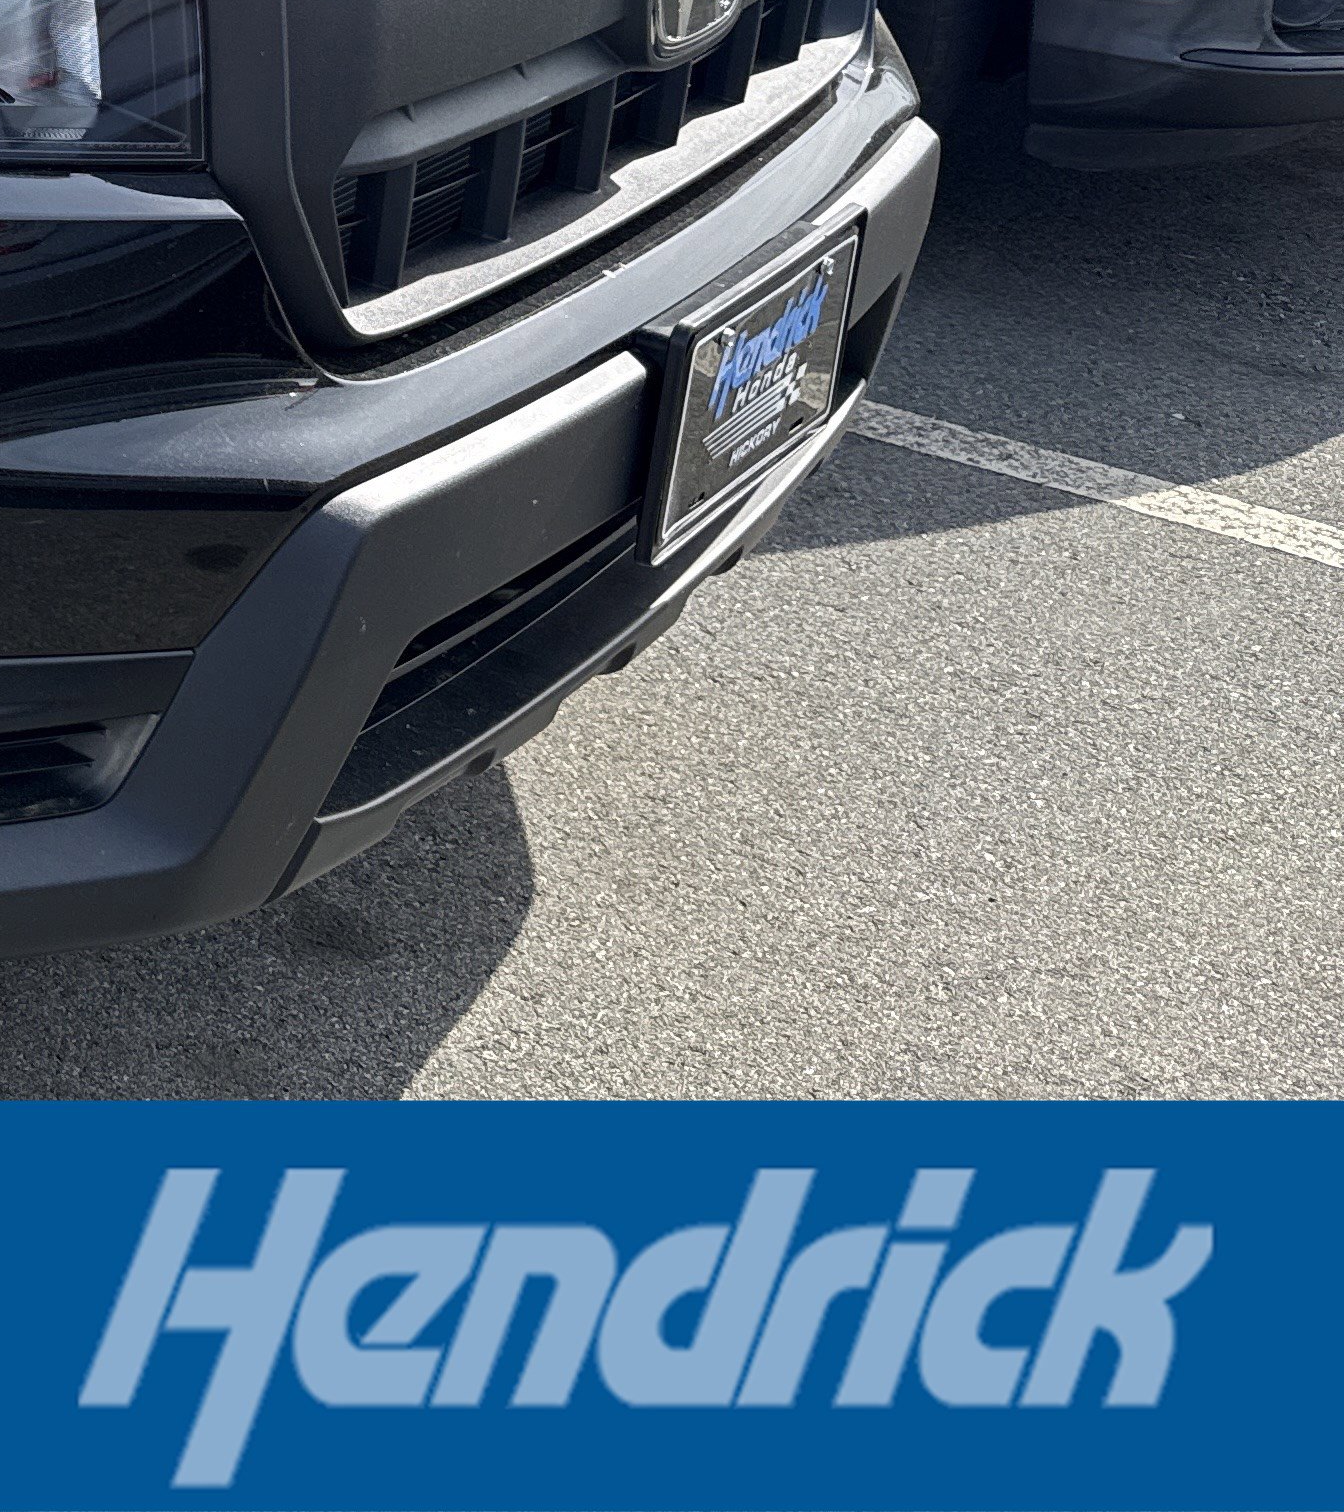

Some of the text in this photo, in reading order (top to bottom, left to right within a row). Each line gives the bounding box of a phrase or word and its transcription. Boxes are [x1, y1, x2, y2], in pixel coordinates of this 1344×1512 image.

[707, 273, 829, 421] Hendrick
[732, 351, 799, 414] Honda
[728, 416, 783, 468] HICKORY
